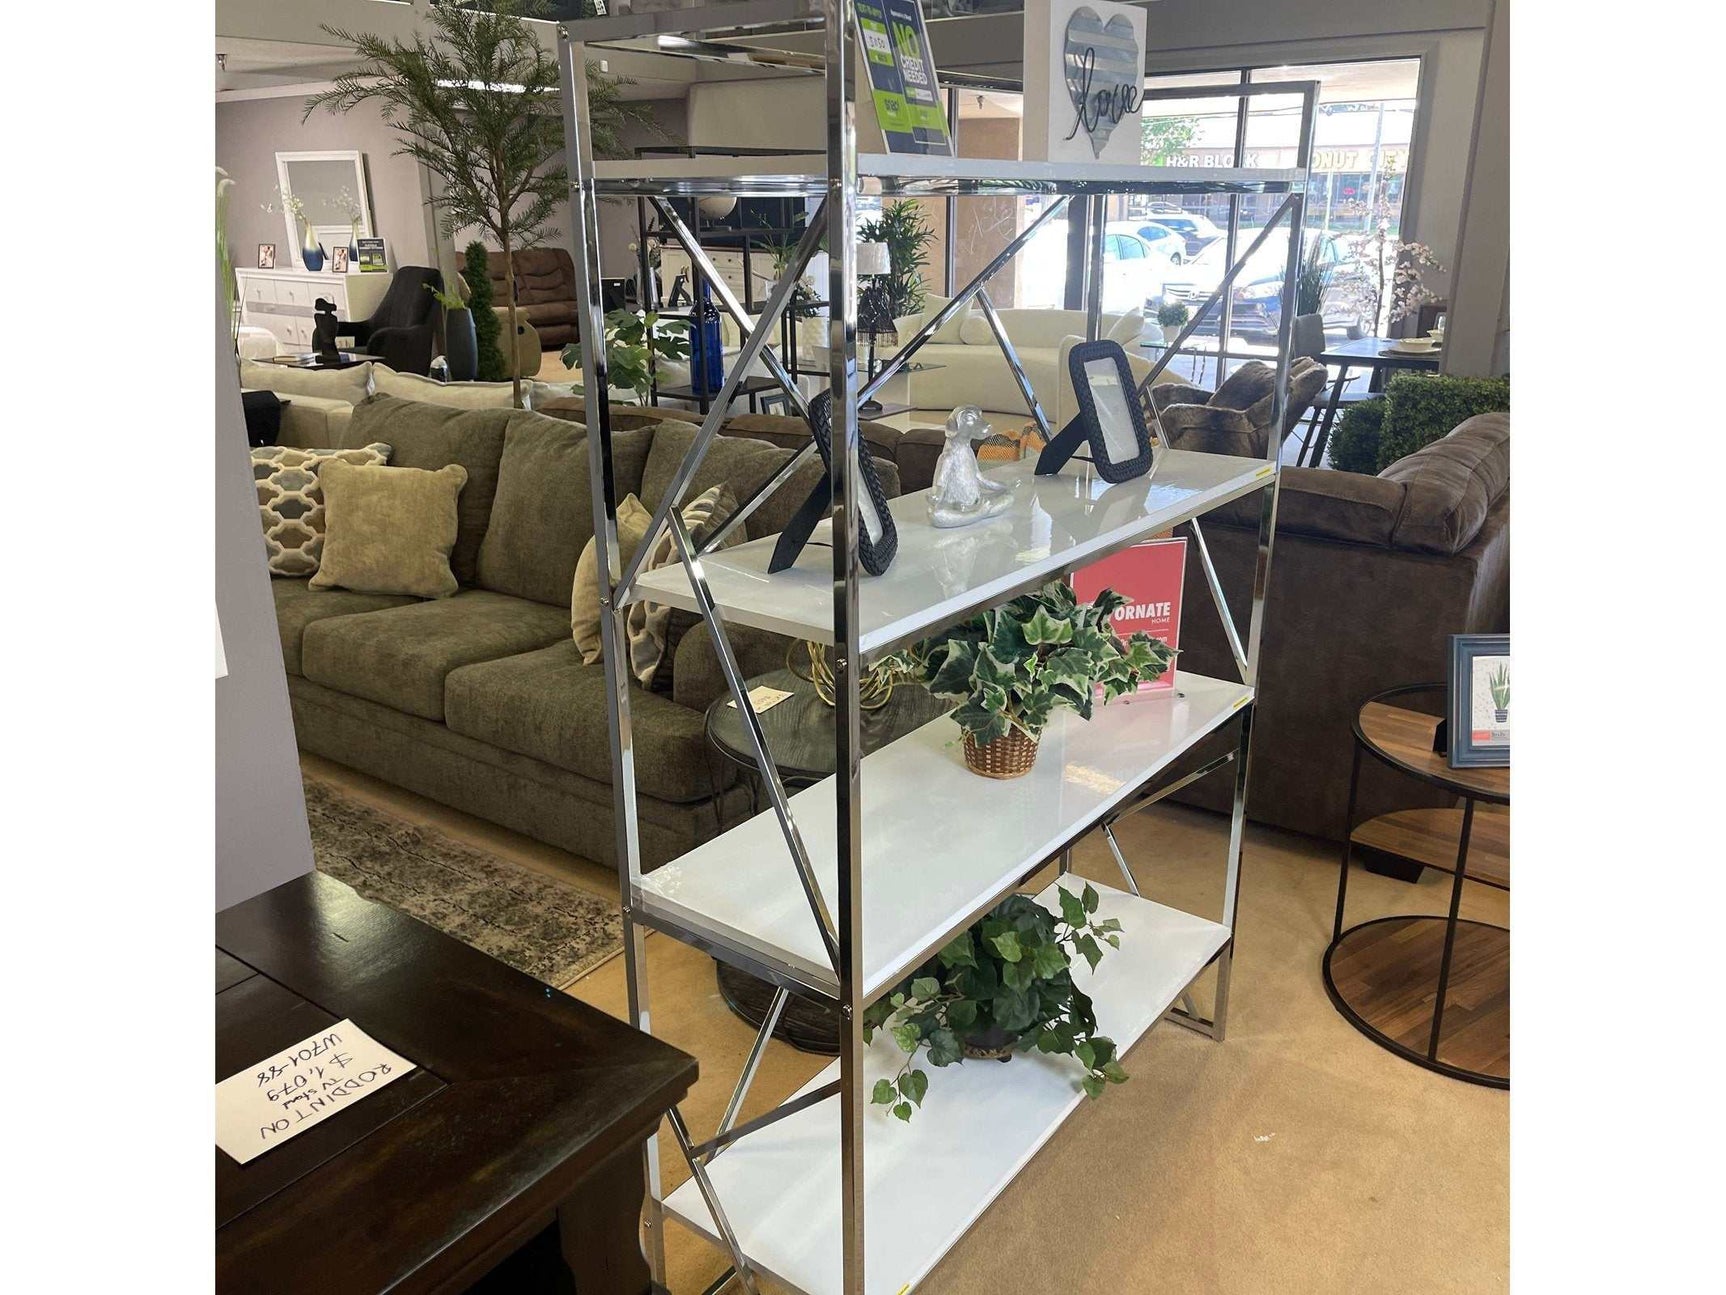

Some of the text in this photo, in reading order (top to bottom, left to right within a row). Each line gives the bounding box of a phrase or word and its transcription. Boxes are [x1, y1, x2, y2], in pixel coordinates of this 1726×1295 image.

[892, 20, 920, 59] NO
[900, 53, 925, 74] CREDIT
[902, 69, 928, 85] NEEDED
[1063, 47, 1146, 141] love
[1166, 153, 1259, 168] H&R BLOK
[1114, 601, 1171, 621] ORNATE
[257, 1033, 343, 1088] W701-88
[322, 1077, 344, 1091] TV
